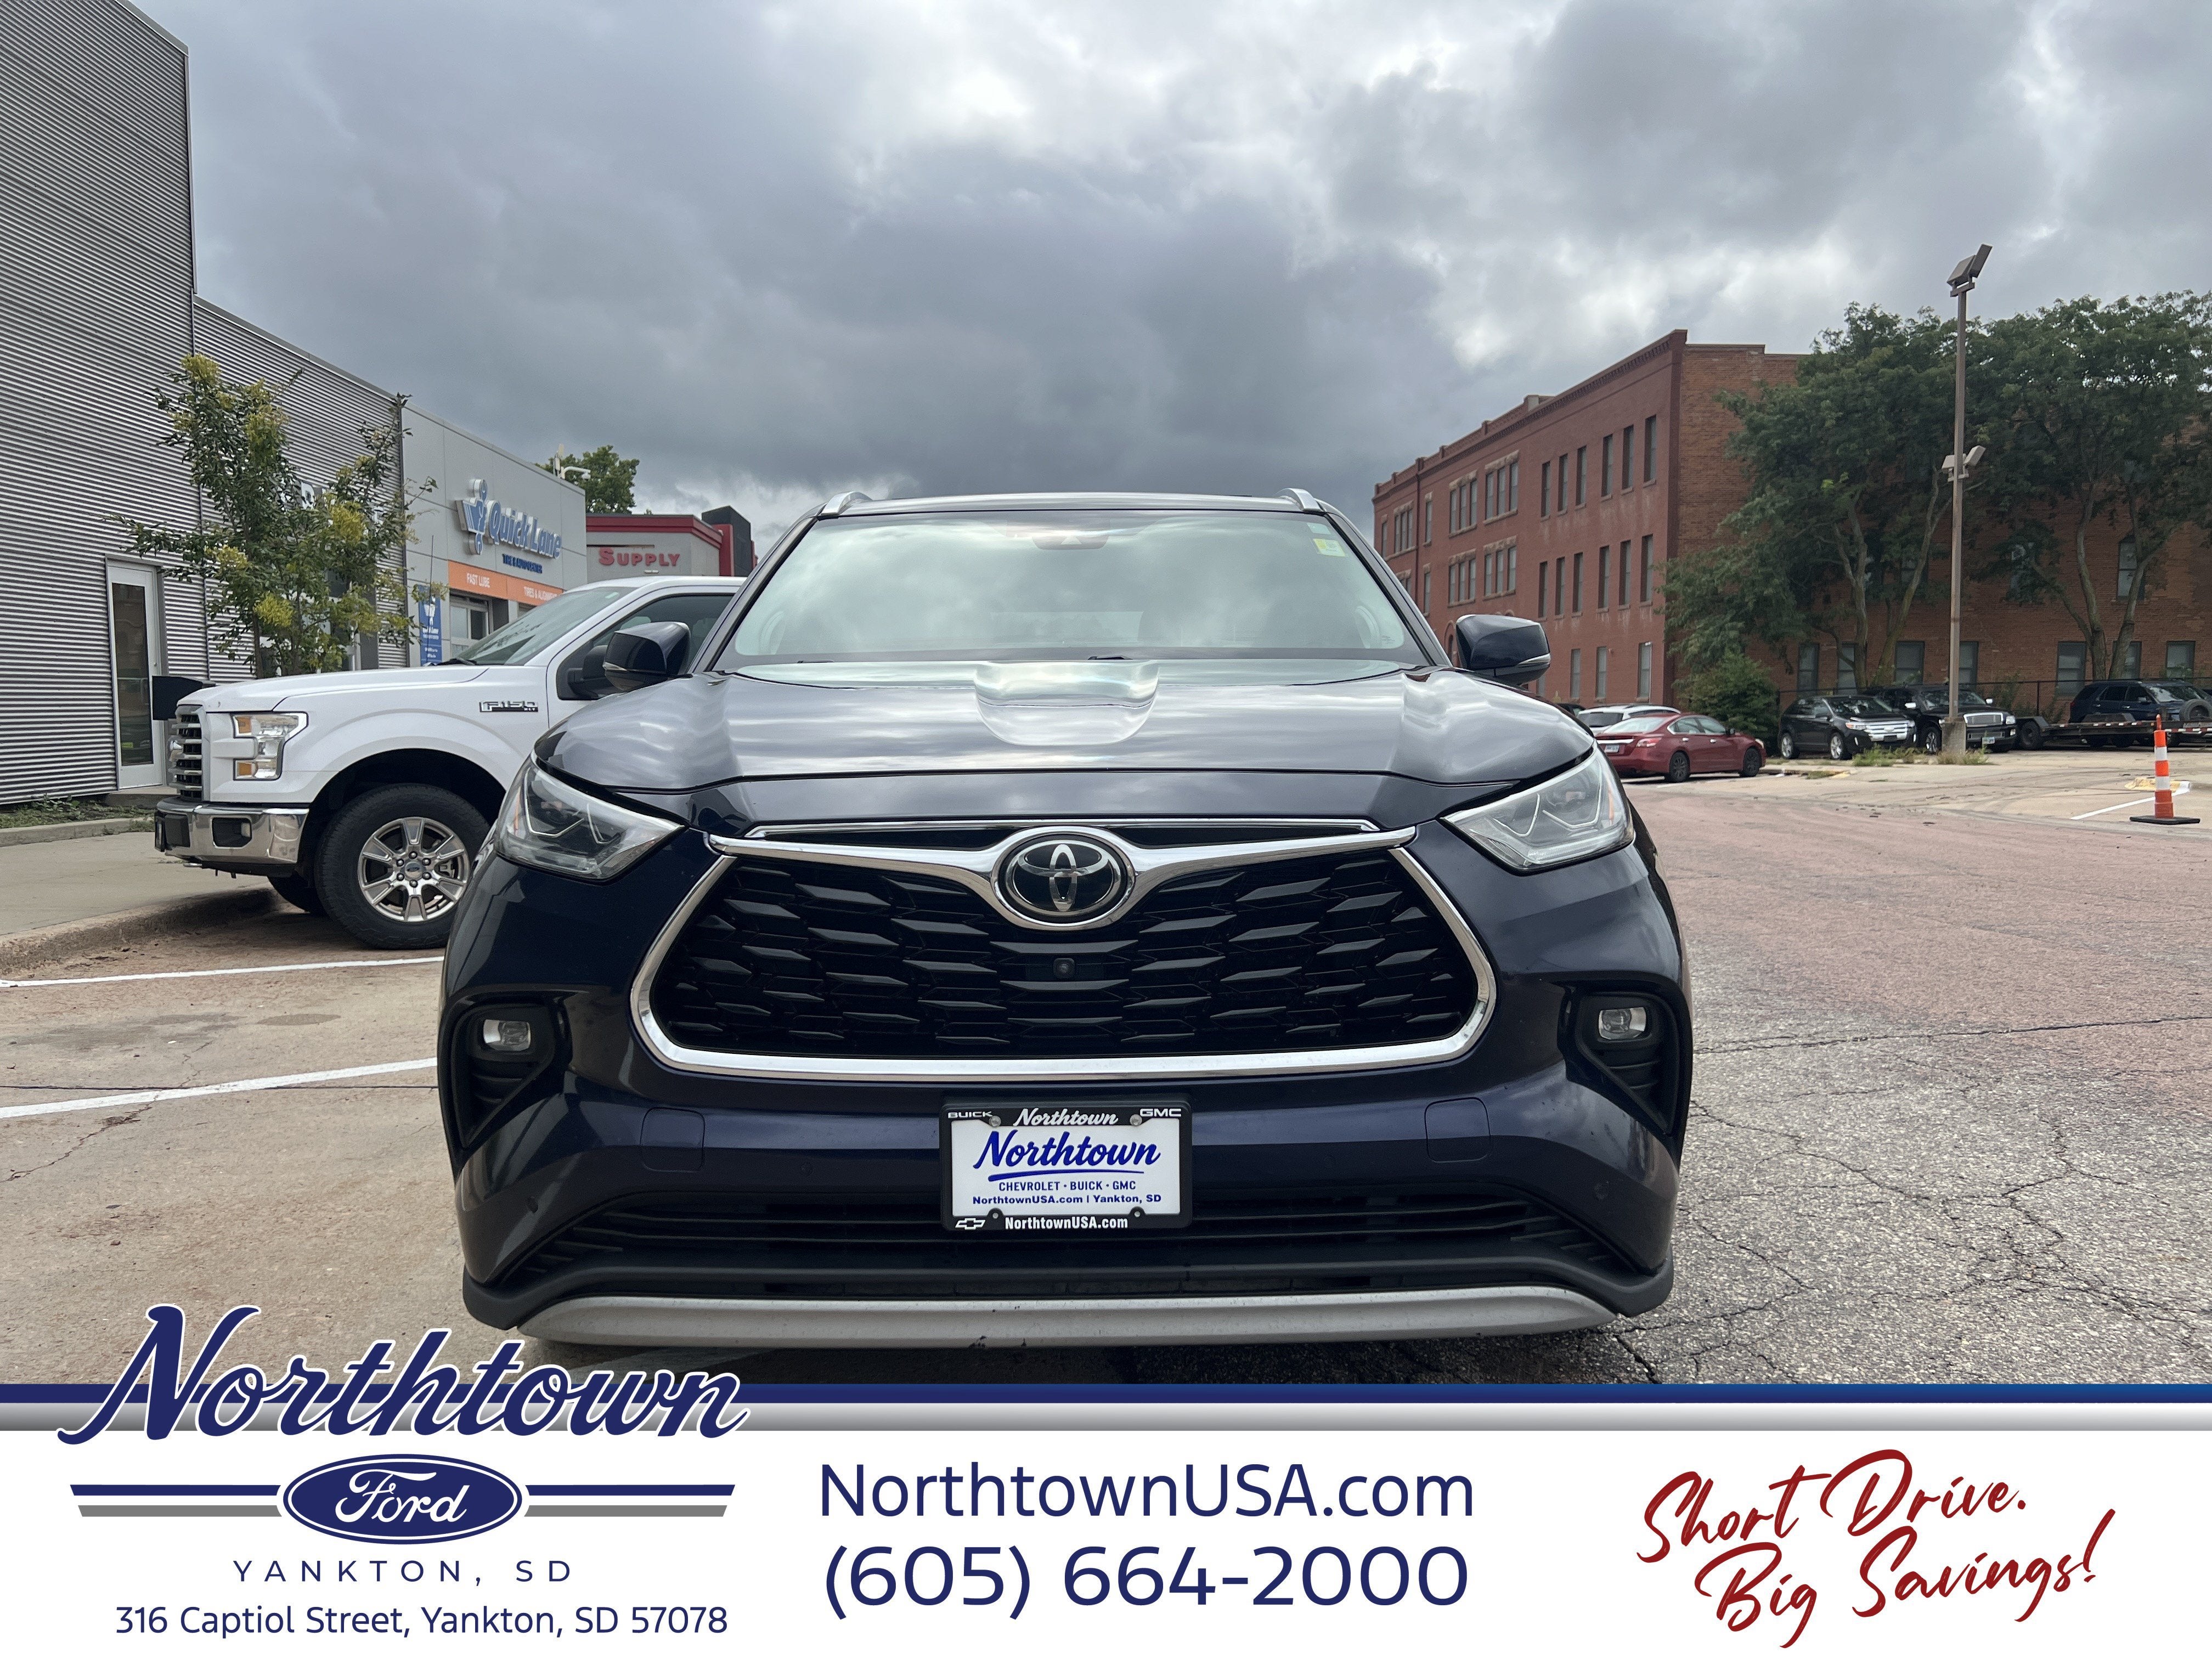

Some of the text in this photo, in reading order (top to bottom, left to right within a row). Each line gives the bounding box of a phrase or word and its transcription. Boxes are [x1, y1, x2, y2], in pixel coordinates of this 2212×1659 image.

[487, 500, 562, 559] Quick Lane
[599, 547, 680, 566] SUPPLY
[467, 573, 490, 588] FAST LUBE
[1013, 1108, 1119, 1126] Northtown
[1139, 1108, 1182, 1117] GMC
[973, 1129, 1161, 1169] Northtown
[998, 1180, 1136, 1191] CHEVROLET BUICK GMC
[972, 1194, 1161, 1204] NorthtownUSA.com Yankton, SD
[1005, 1216, 1128, 1229] NorthtownUSA.com
